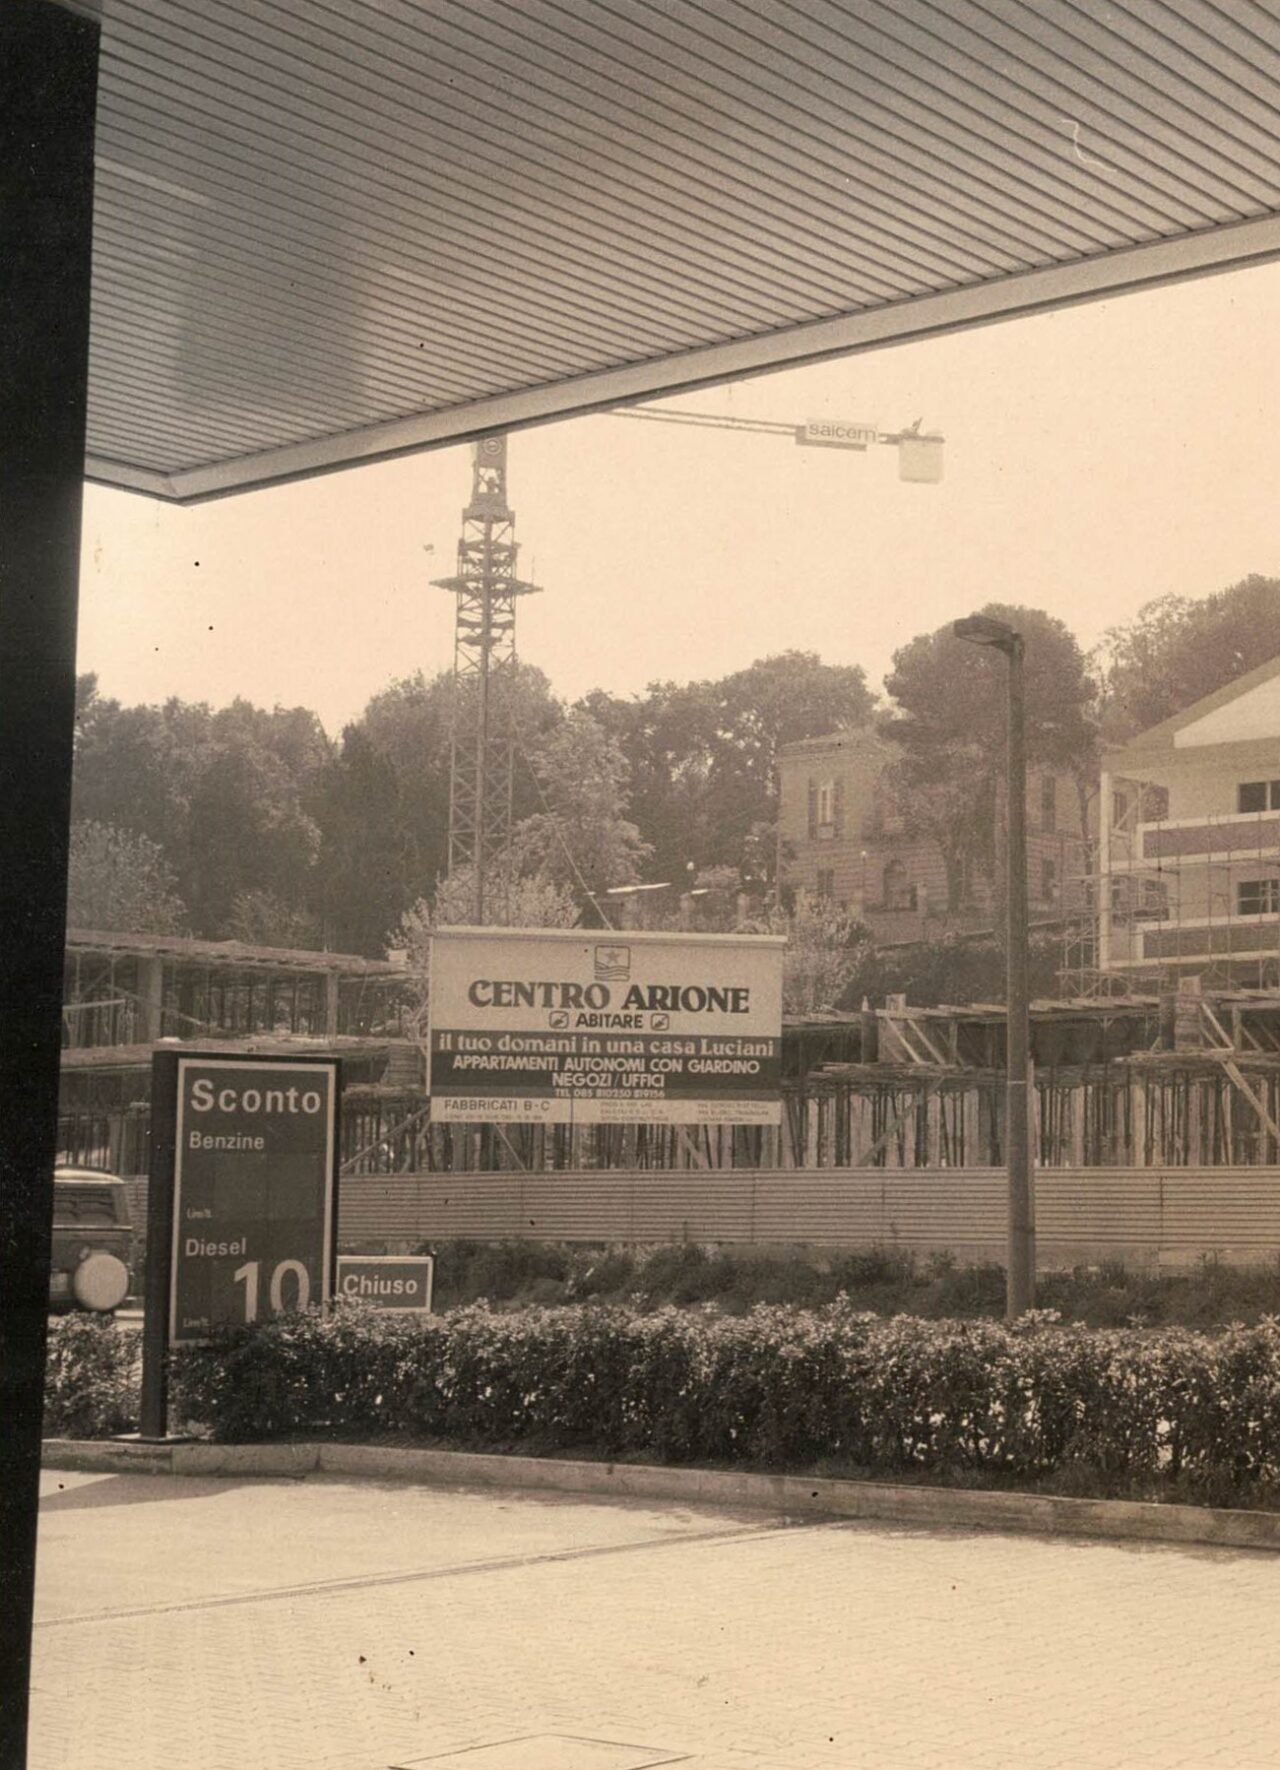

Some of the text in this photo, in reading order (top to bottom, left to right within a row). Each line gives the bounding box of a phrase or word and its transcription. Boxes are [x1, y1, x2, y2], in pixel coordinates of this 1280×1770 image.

[468, 980, 750, 1014] CENTRO ARIONE
[575, 1013, 643, 1029] ABITARE
[438, 1033, 774, 1057] il tuo domani in una casa Luciani
[452, 1055, 760, 1074] APPARTAMENTI AUTONOMI CON GIARDINO
[552, 1073, 612, 1087] NEGOZI
[622, 1074, 665, 1088] UFFICI
[190, 1079, 322, 1113] Sconto
[444, 1100, 518, 1111] FABBRICATI
[189, 1131, 265, 1150] Benzine
[185, 1237, 247, 1256] Diesel
[232, 1259, 311, 1323] 10
[343, 1274, 419, 1295] Chiuso
